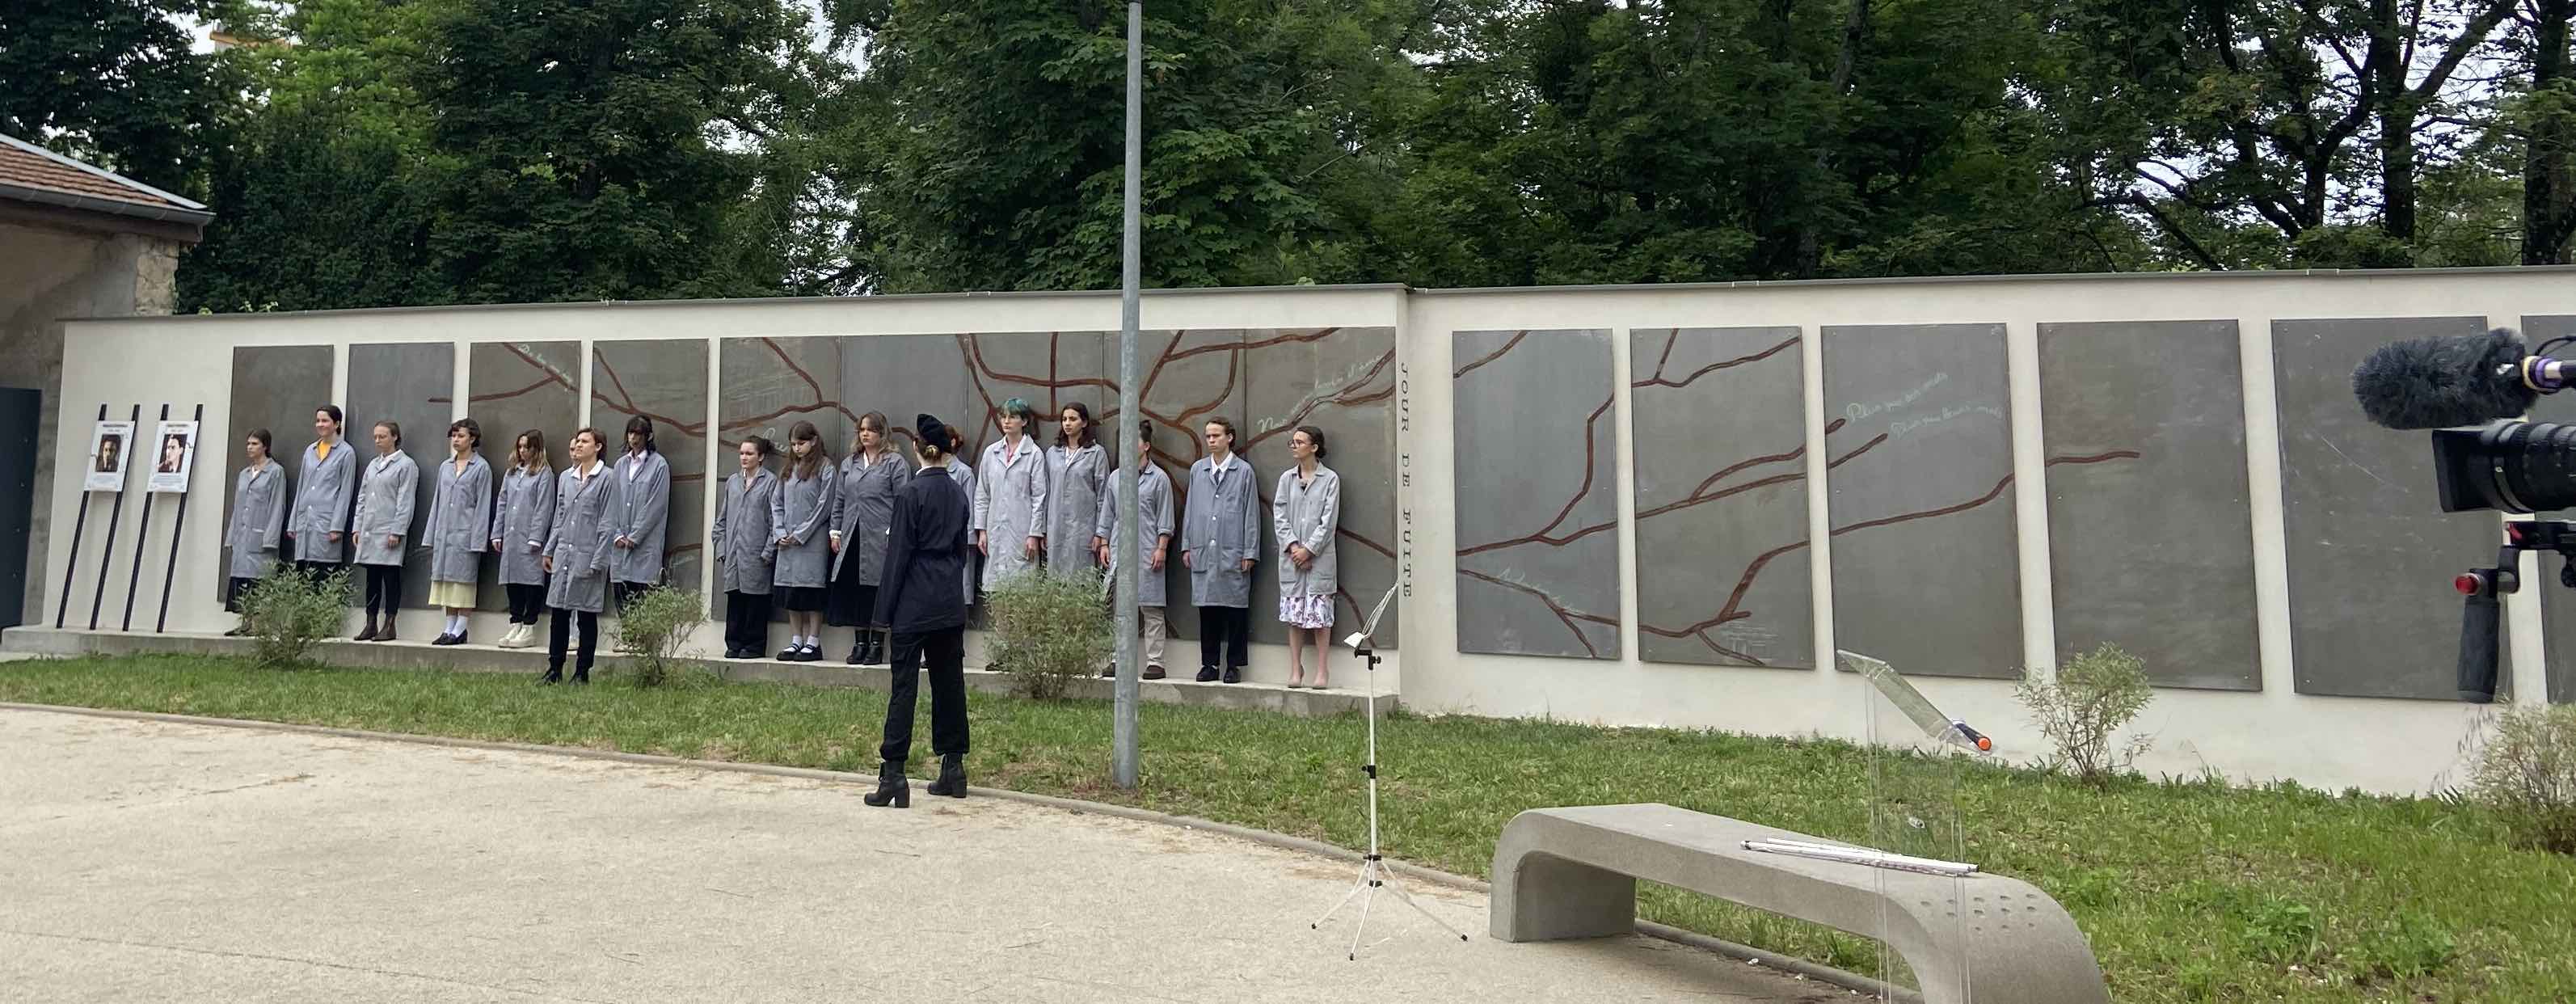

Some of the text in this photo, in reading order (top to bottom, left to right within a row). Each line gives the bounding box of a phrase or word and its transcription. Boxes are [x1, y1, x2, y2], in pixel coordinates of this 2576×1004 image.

[1401, 361, 1412, 597] JOUR DE FUITE
